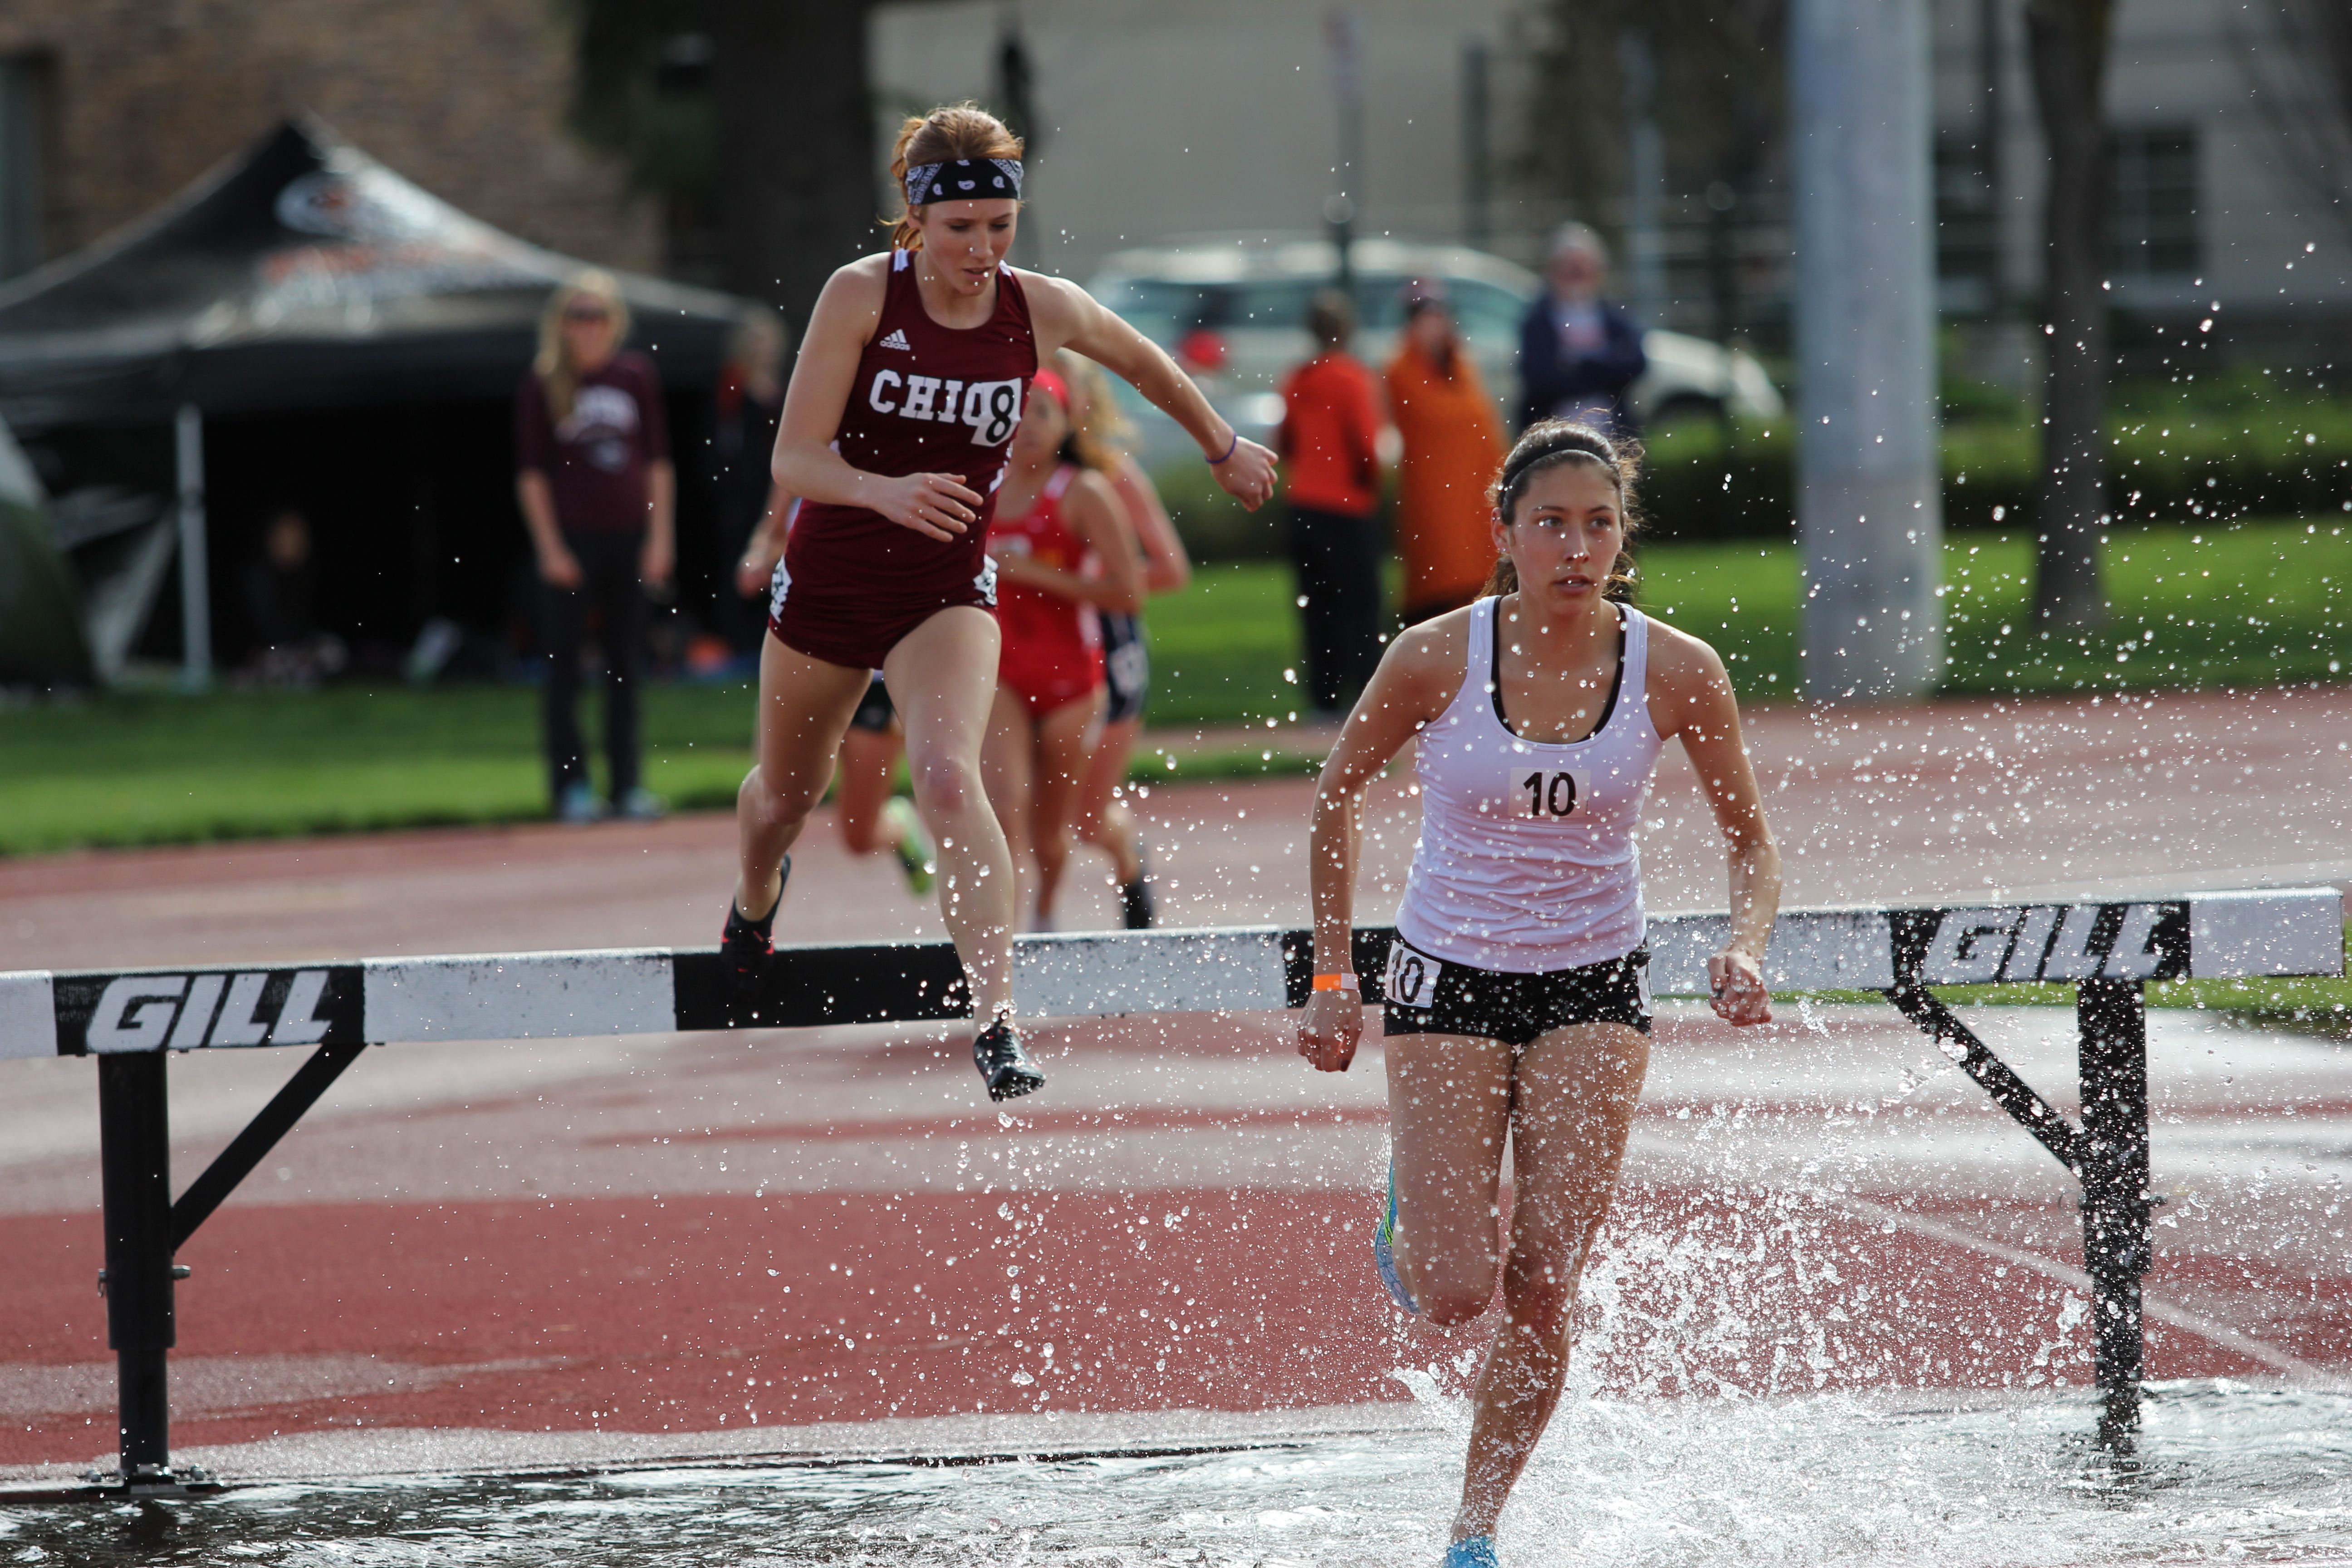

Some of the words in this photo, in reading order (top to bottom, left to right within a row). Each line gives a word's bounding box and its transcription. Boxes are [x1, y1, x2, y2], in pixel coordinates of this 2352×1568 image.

[879, 340, 911, 352] adidas
[985, 385, 1014, 444] 8
[1523, 771, 1577, 817] 10
[1923, 902, 2163, 982] GILL
[1392, 948, 1425, 1004] 10
[86, 970, 332, 1054] GILL
